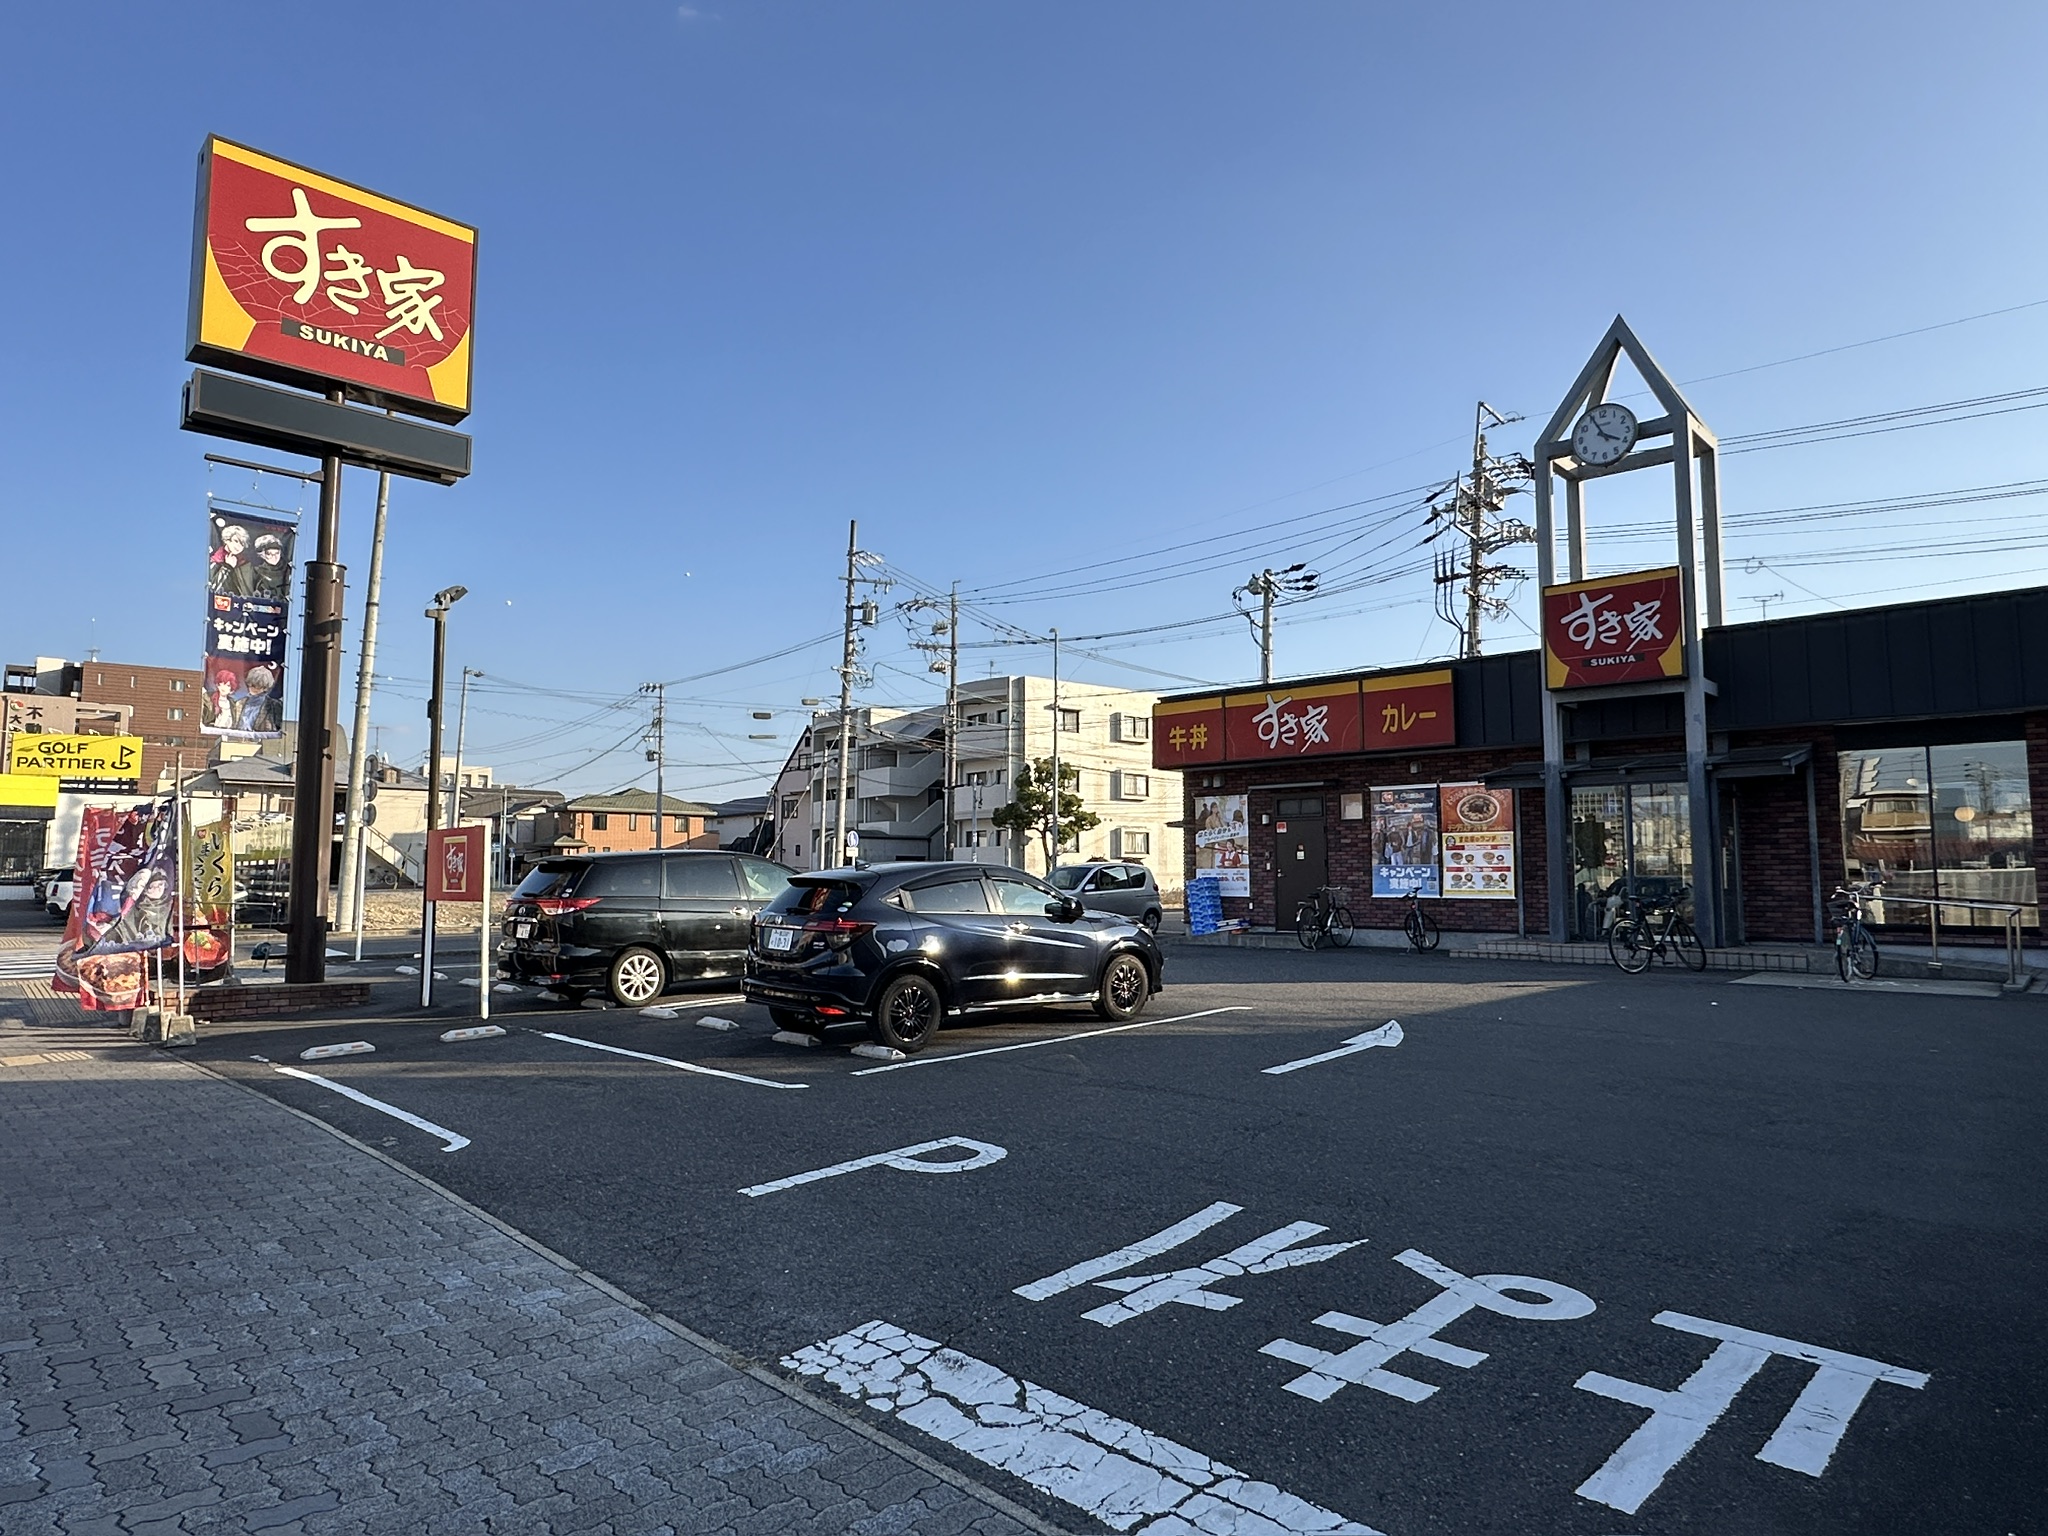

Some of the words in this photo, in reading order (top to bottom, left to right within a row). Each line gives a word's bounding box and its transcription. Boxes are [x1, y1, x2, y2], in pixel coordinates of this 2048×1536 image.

[245, 187, 445, 342] すき家
[299, 324, 389, 362] SUKIYA
[1599, 410, 1607, 419] 12
[1613, 410, 1616, 418] 1
[1620, 415, 1626, 425] 2
[1625, 425, 1631, 434] 3
[1578, 436, 1584, 445] 9
[1582, 446, 1588, 455] 8
[1591, 451, 1597, 460] 7
[1602, 451, 1608, 460] 6
[1613, 446, 1619, 455] 5
[213, 617, 280, 638] キャンペーン
[1560, 592, 1663, 653] すき家
[1590, 654, 1636, 667] SUKIYA
[1168, 722, 1208, 752] 牛丼
[1251, 693, 1330, 754] すき家
[1381, 703, 1437, 735] カレー
[38, 741, 89, 755] GOLF
[16, 756, 106, 770] PARTNER
[207, 831, 227, 898] いくら
[446, 844, 464, 878] すき家
[1380, 866, 1431, 878] キャンペーン
[738, 1136, 1009, 1197] P
